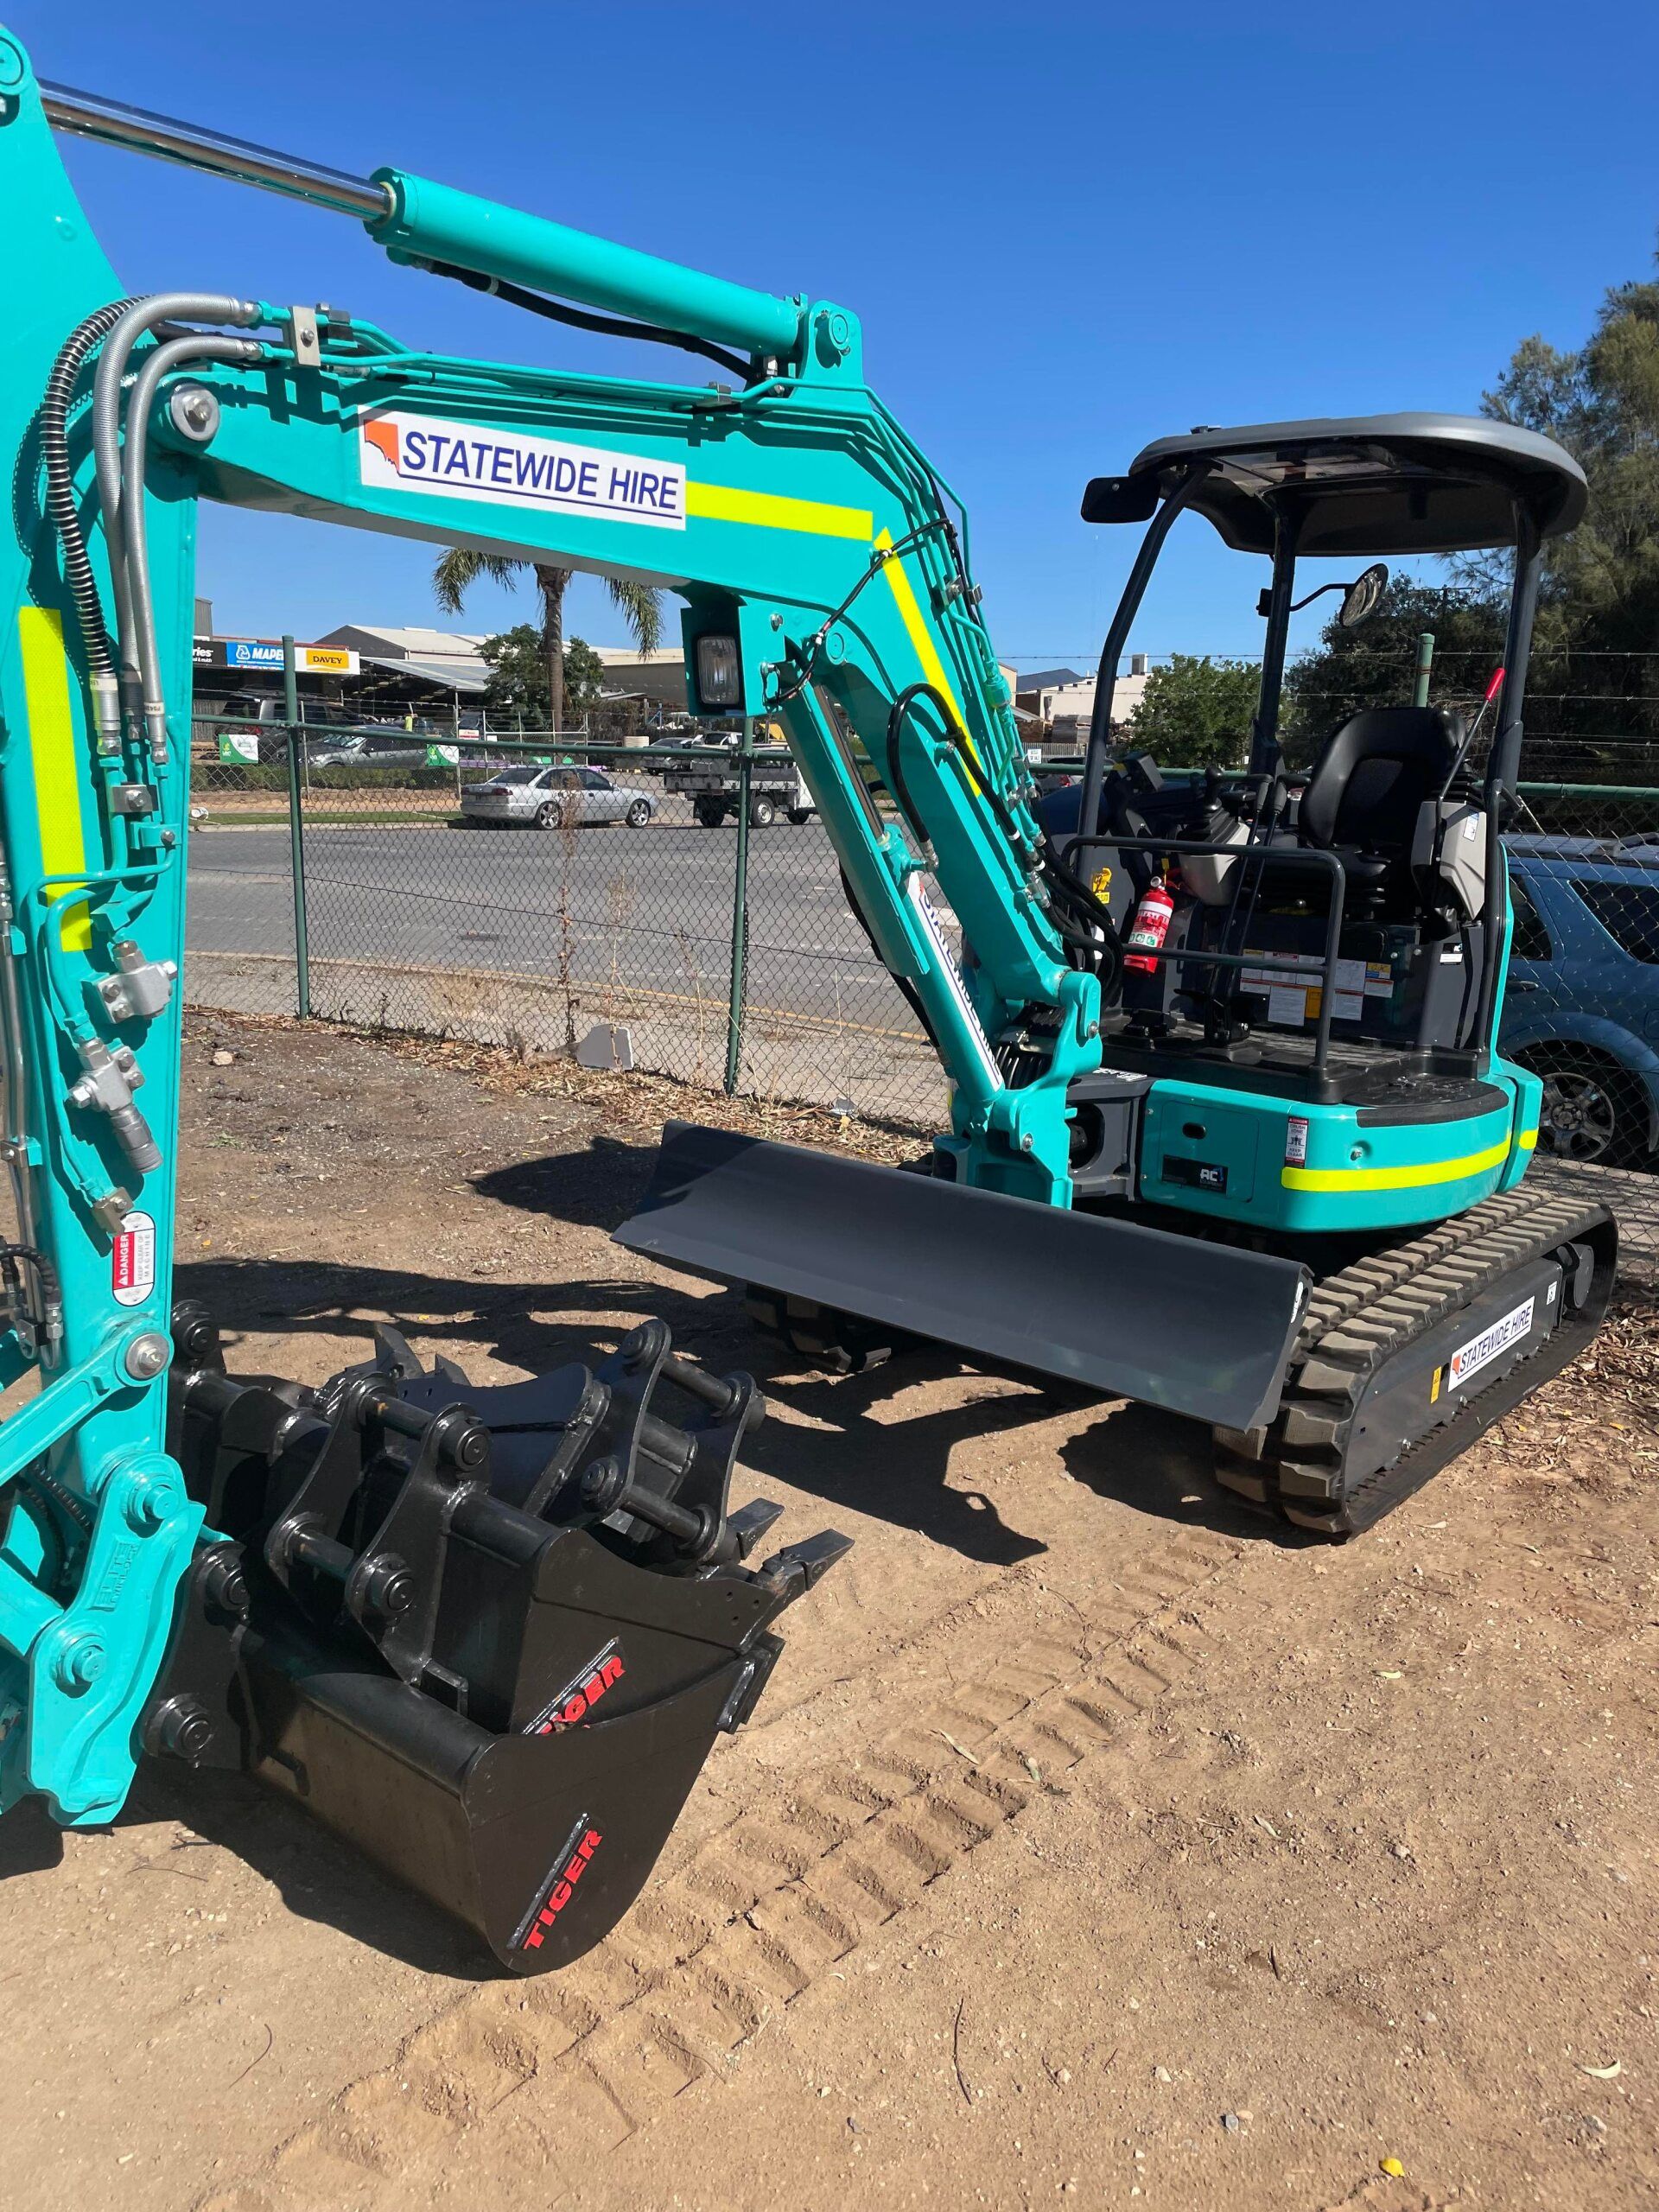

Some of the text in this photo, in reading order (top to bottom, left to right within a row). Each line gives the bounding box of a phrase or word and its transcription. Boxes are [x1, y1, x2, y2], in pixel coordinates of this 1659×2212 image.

[403, 431, 678, 510] STATEWIDE HIRE
[251, 647, 283, 660] MAPE
[313, 655, 342, 664] DAVEY
[1200, 1168, 1218, 1182] AC
[120, 1234, 129, 1275] DANGER
[1460, 1306, 1532, 1372] STATEWIDE HIRE
[535, 1655, 626, 1734] GER
[524, 1829, 602, 1950] TIGER
